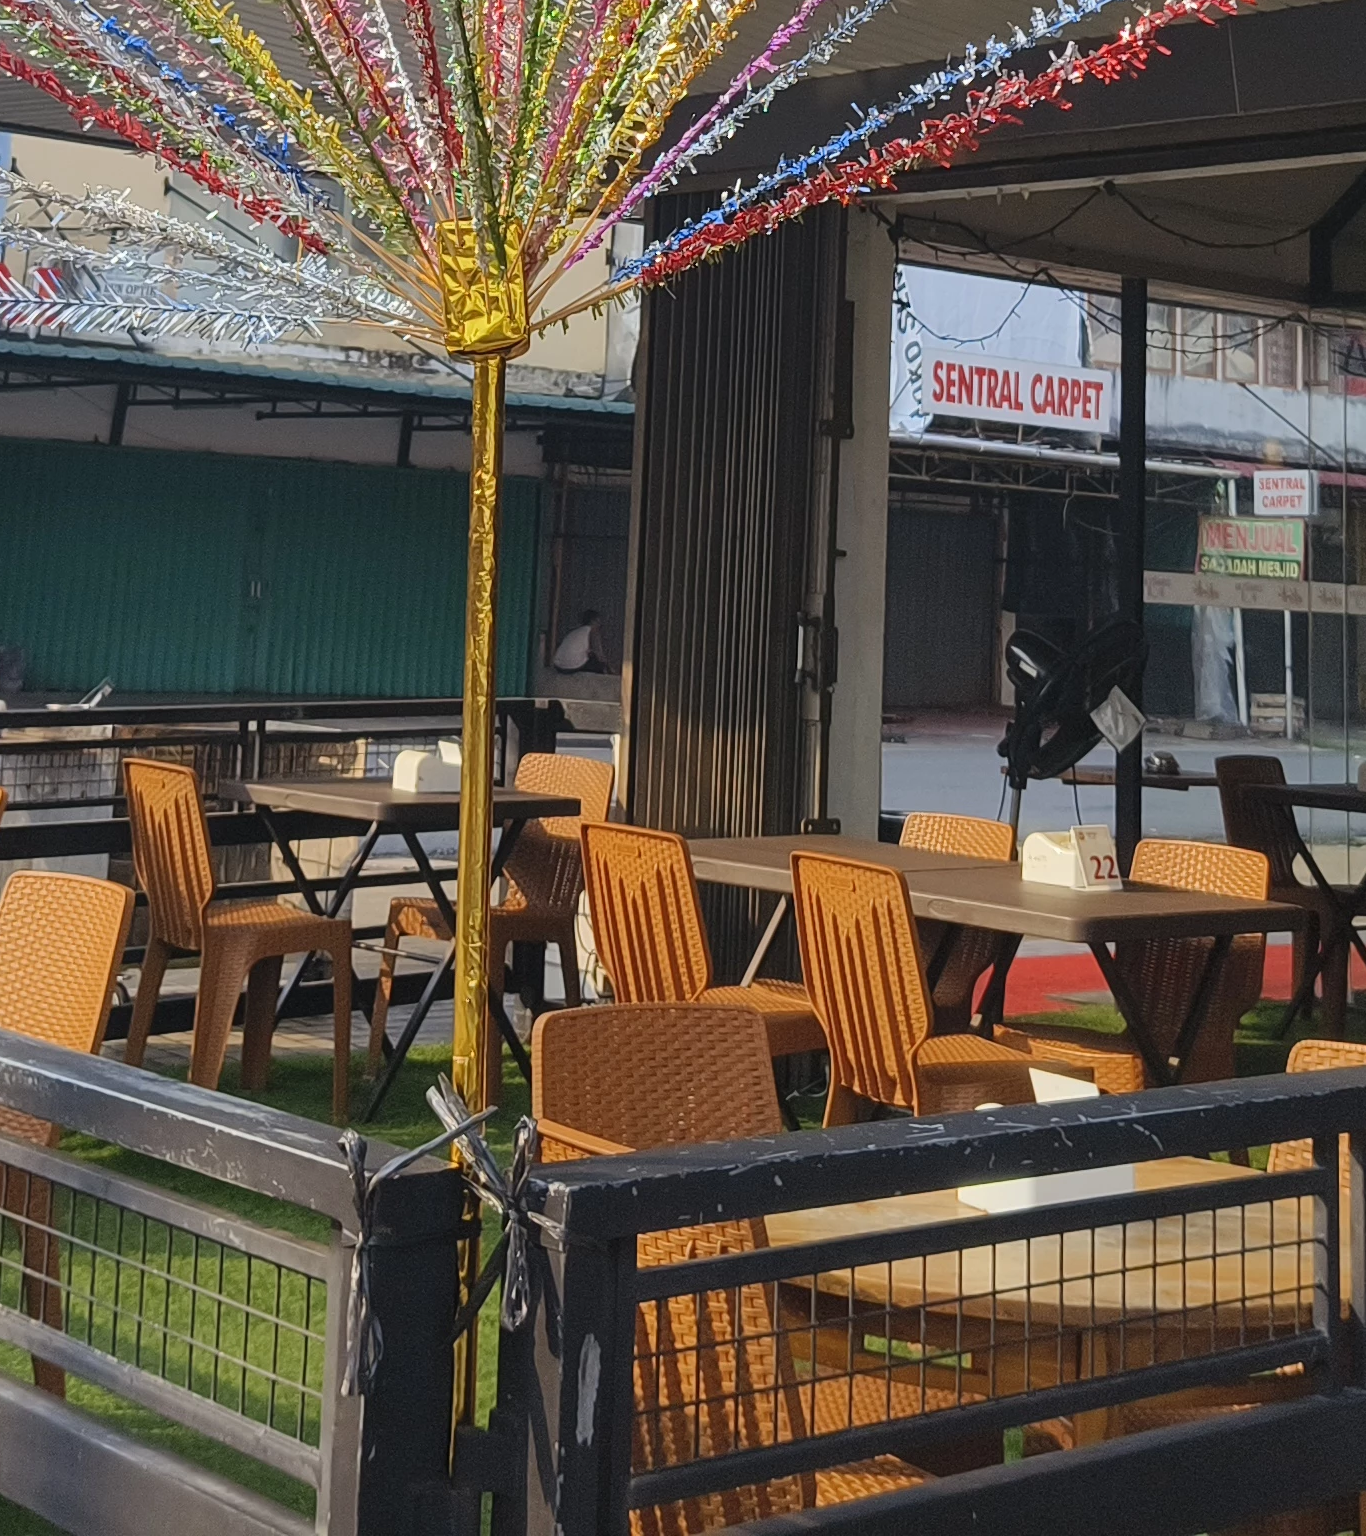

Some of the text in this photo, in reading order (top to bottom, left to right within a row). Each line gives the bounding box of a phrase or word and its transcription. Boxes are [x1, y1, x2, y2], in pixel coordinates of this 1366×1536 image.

[932, 360, 1104, 420] SENTRAL CARPET
[1258, 477, 1306, 491] SENTRAL
[1261, 495, 1303, 509] CARPET
[1203, 521, 1297, 555] MENJUAL
[1258, 559, 1300, 578] MESJID
[1090, 854, 1119, 880] 22
